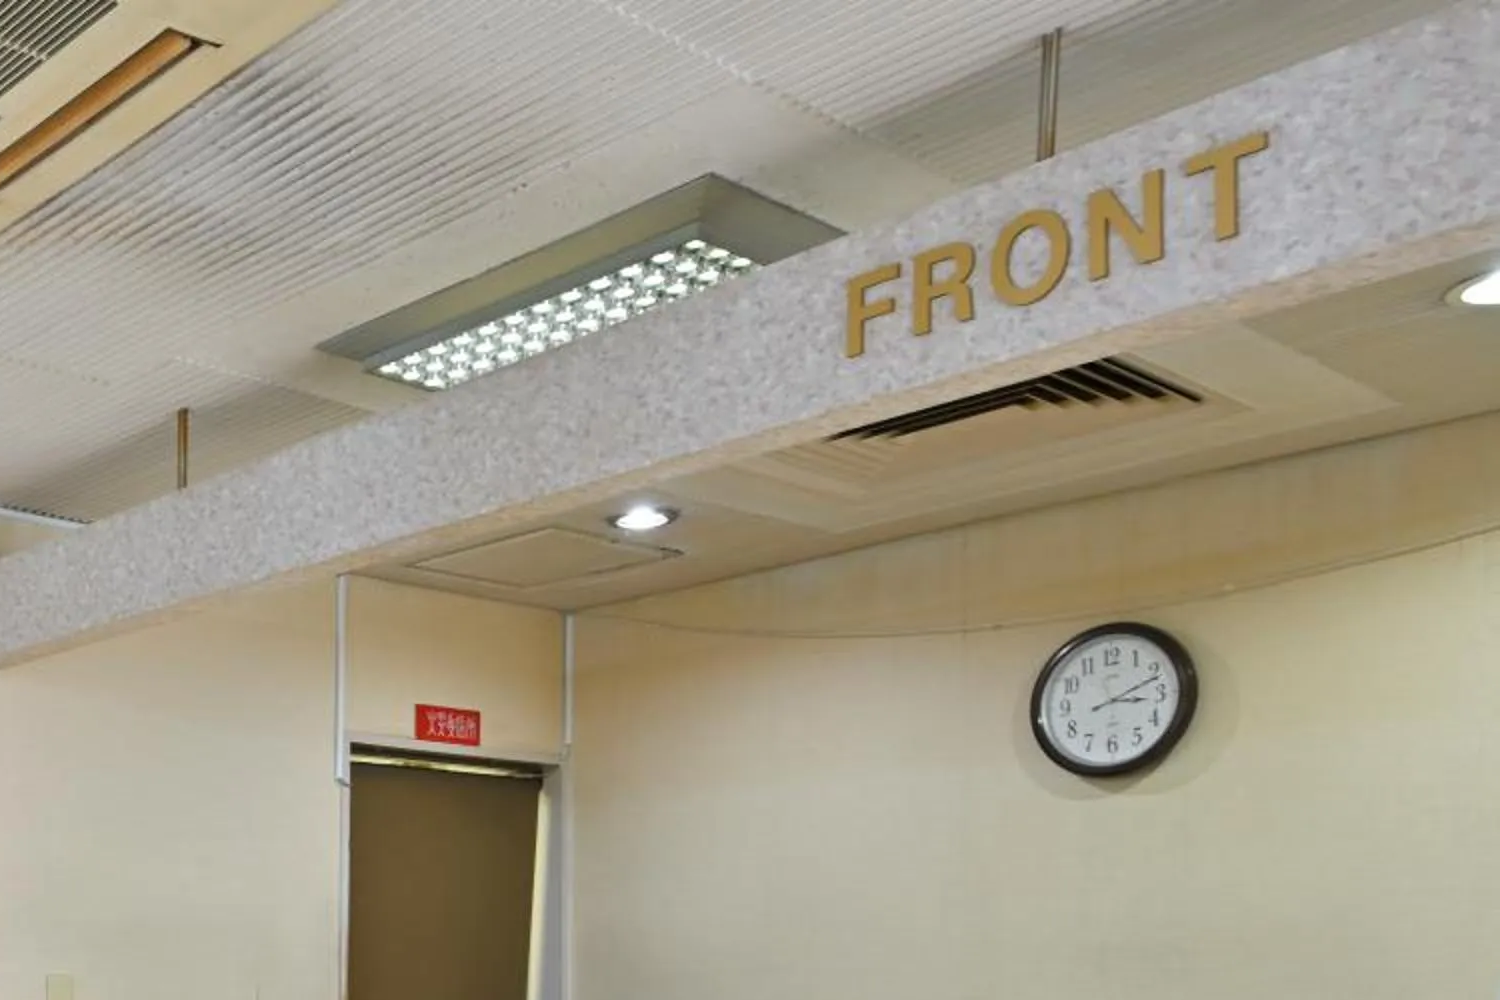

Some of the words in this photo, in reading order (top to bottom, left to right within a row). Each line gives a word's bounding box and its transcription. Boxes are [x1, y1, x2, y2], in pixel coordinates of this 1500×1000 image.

[844, 128, 1270, 358] FRONT
[1081, 656, 1094, 677] 11
[1103, 646, 1121, 667] 12
[1131, 649, 1140, 668] 1
[1064, 675, 1079, 696] 10
[1154, 682, 1167, 704] 3
[1059, 698, 1071, 717] 9
[1148, 707, 1159, 727] 4
[1067, 719, 1077, 739] 8
[1132, 727, 1143, 747] 5
[1084, 733, 1095, 752] 7
[1107, 734, 1119, 754] 6
